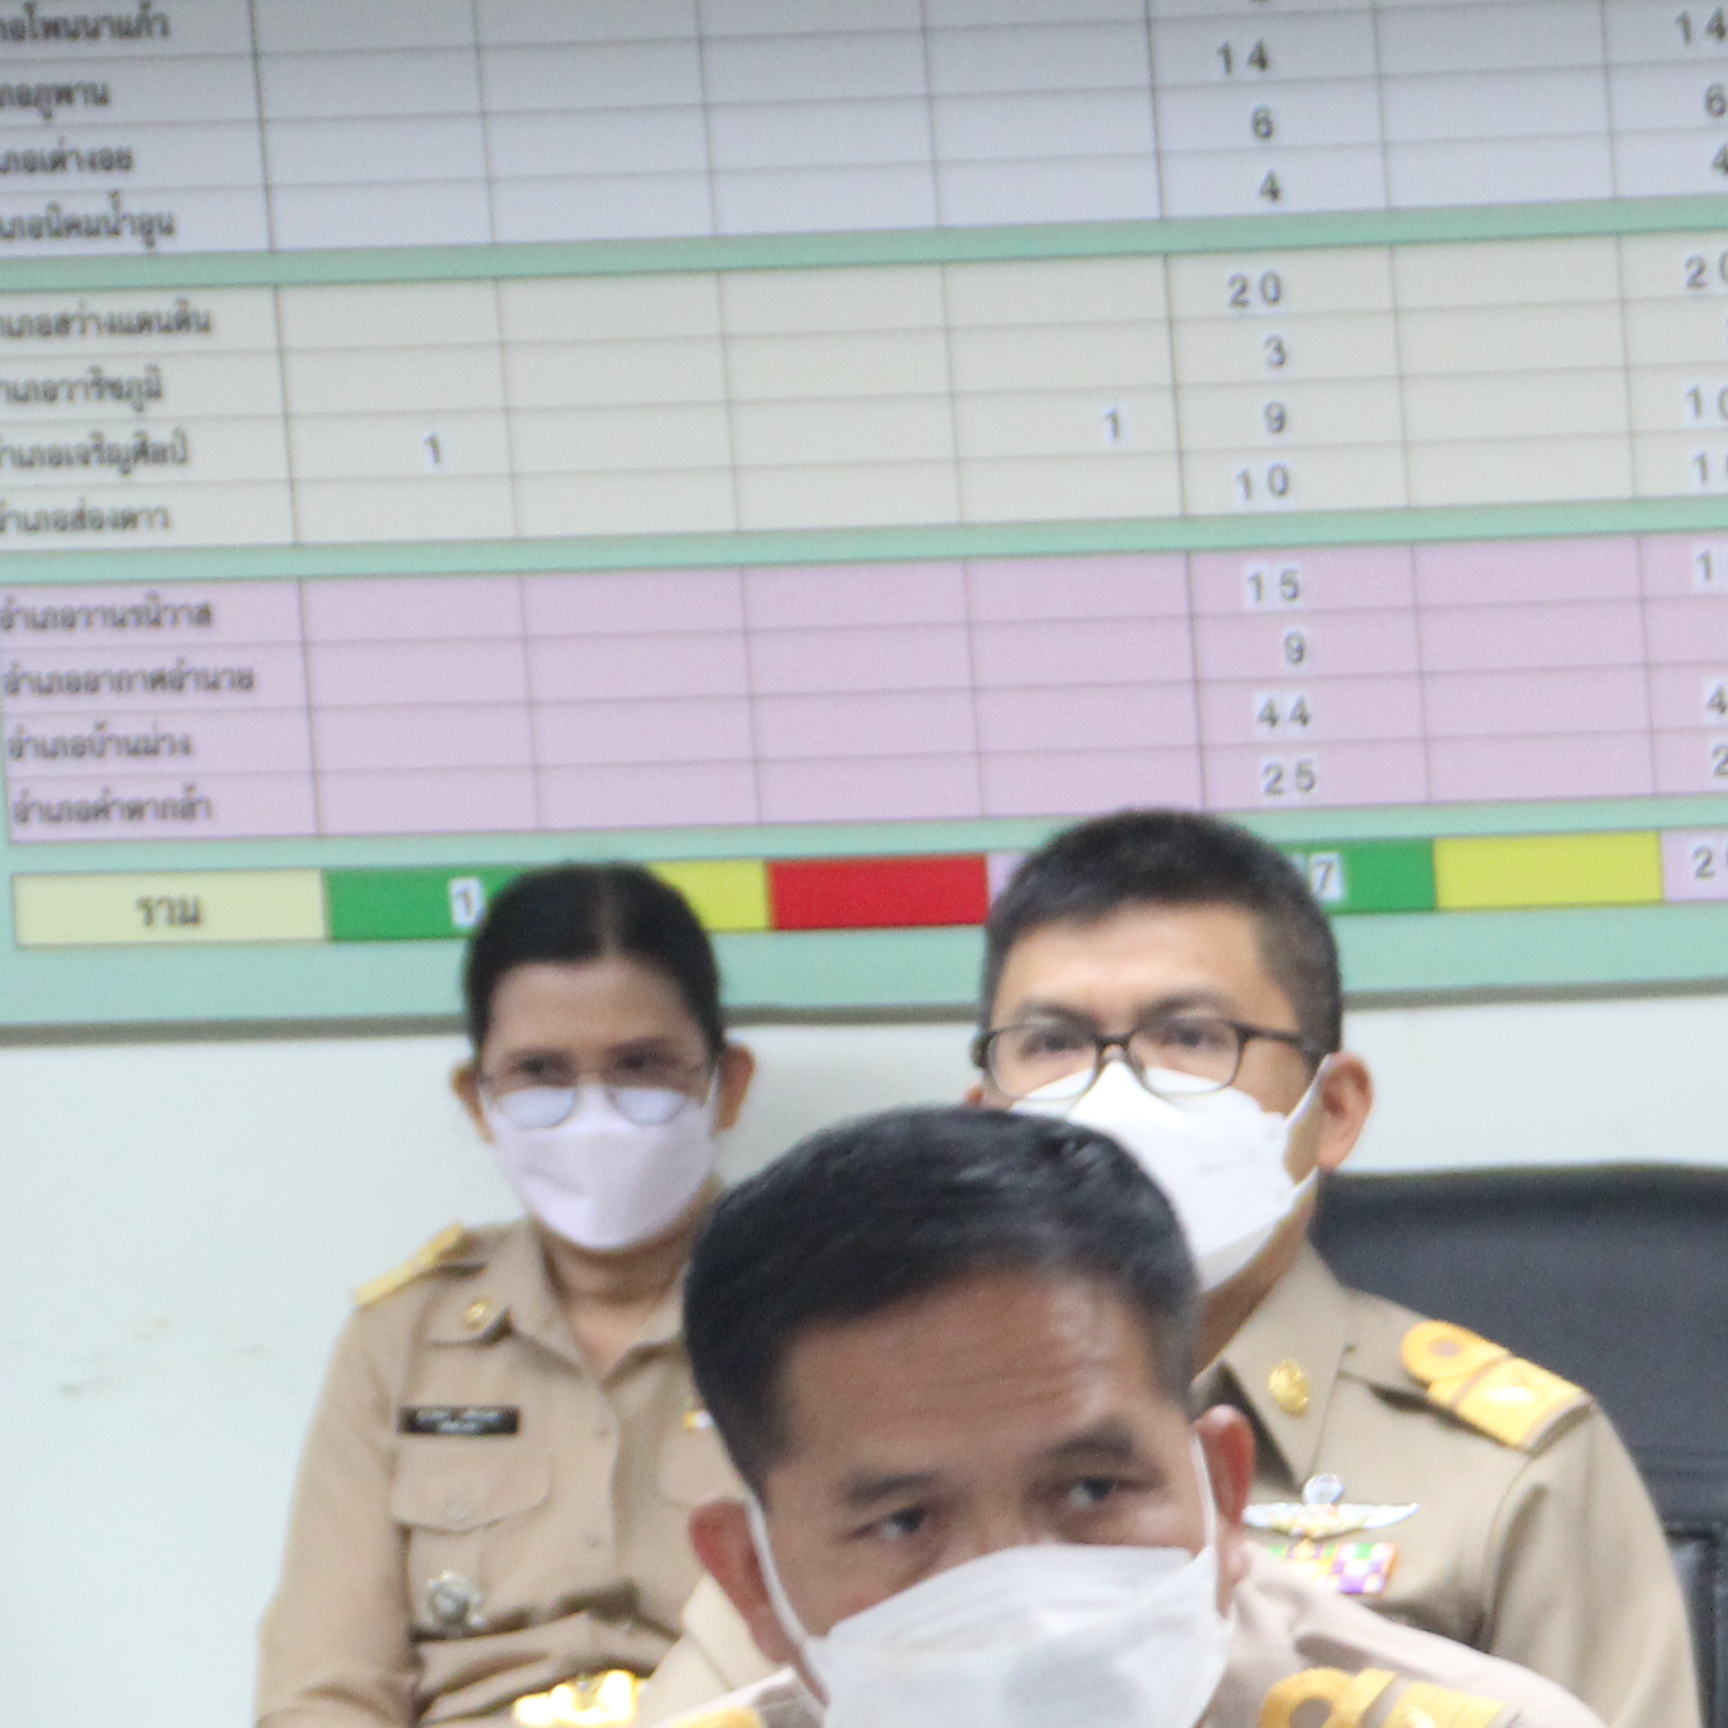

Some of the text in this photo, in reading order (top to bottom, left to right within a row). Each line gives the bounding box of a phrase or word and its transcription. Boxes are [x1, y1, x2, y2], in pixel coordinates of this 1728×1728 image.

[1218, 40, 1271, 75] 14
[1676, 8, 1728, 44] 14
[1251, 107, 1275, 142] 6
[1704, 83, 1728, 119] 6
[1259, 172, 1282, 203] 4
[1228, 271, 1284, 310] 20
[1265, 336, 1289, 370] 3
[424, 433, 442, 465] 1
[1105, 409, 1122, 440] 1
[1264, 403, 1288, 435] 9
[1237, 464, 1292, 500] 10
[1248, 569, 1303, 603] 15
[1284, 635, 1307, 666] 9
[1258, 698, 1312, 729] 44
[1264, 760, 1318, 797] 25
[138, 893, 202, 930] รวม
[454, 886, 477, 920] 1
